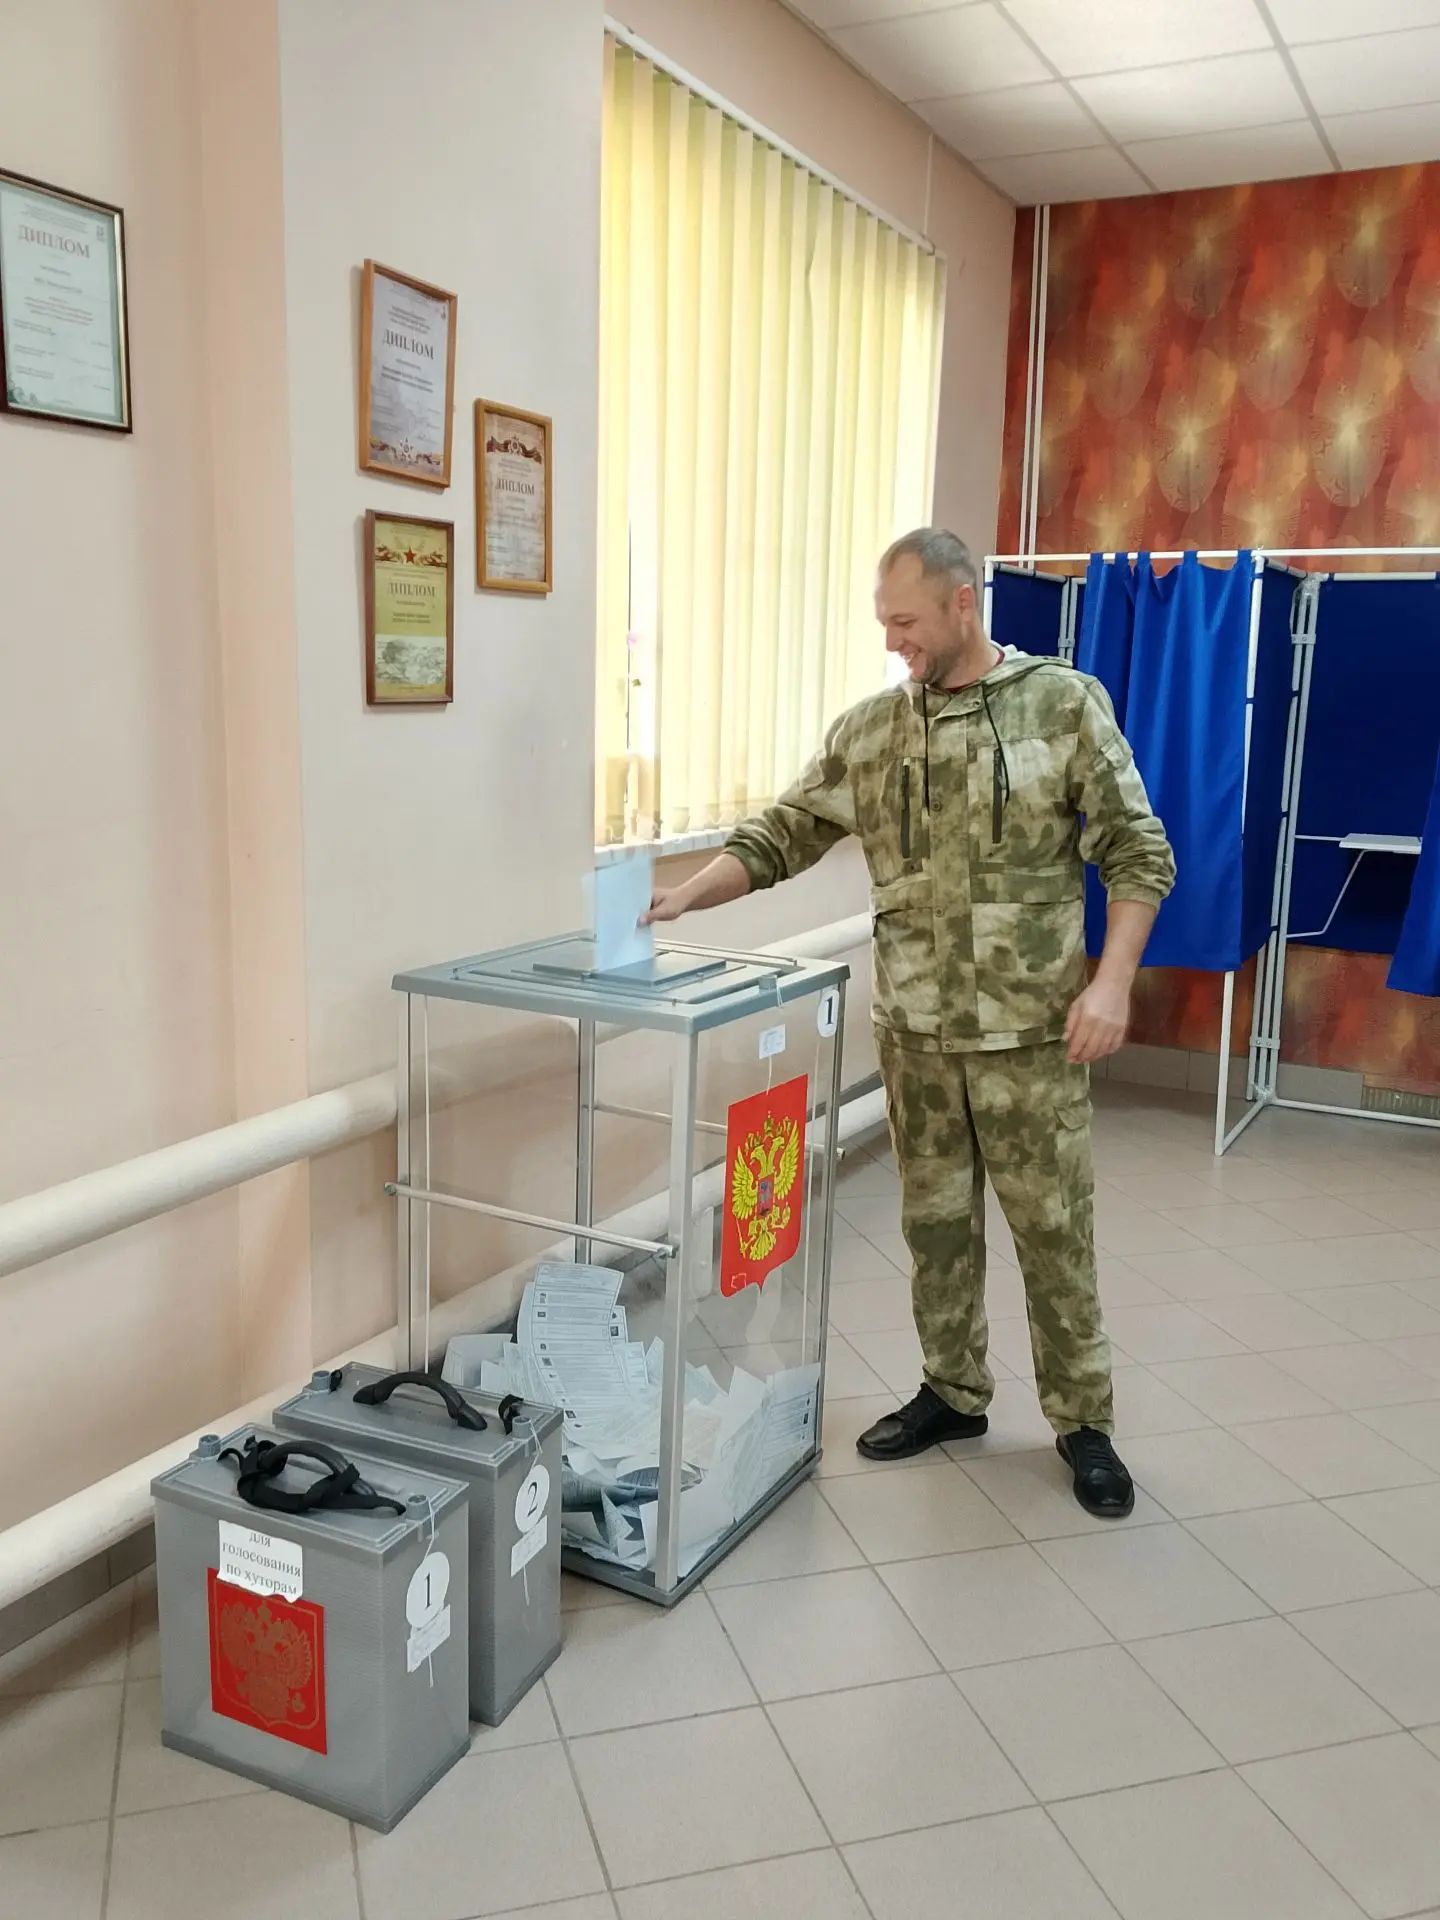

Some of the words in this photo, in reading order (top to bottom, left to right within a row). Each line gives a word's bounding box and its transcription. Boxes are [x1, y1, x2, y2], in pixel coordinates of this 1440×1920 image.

[18, 225, 91, 258] ДИПЛОМ
[383, 329, 434, 360] ДИПЛОМ
[496, 479, 535, 496] ДИПЛОМ
[387, 581, 435, 598] ДИПЛОМ
[825, 996, 835, 1025] 1
[527, 1481, 538, 1516] 2
[249, 1531, 271, 1547] для
[222, 1542, 301, 1577] голосования
[226, 1563, 241, 1576] по
[244, 1568, 297, 1595] хуторам
[423, 1573, 431, 1609] 1
